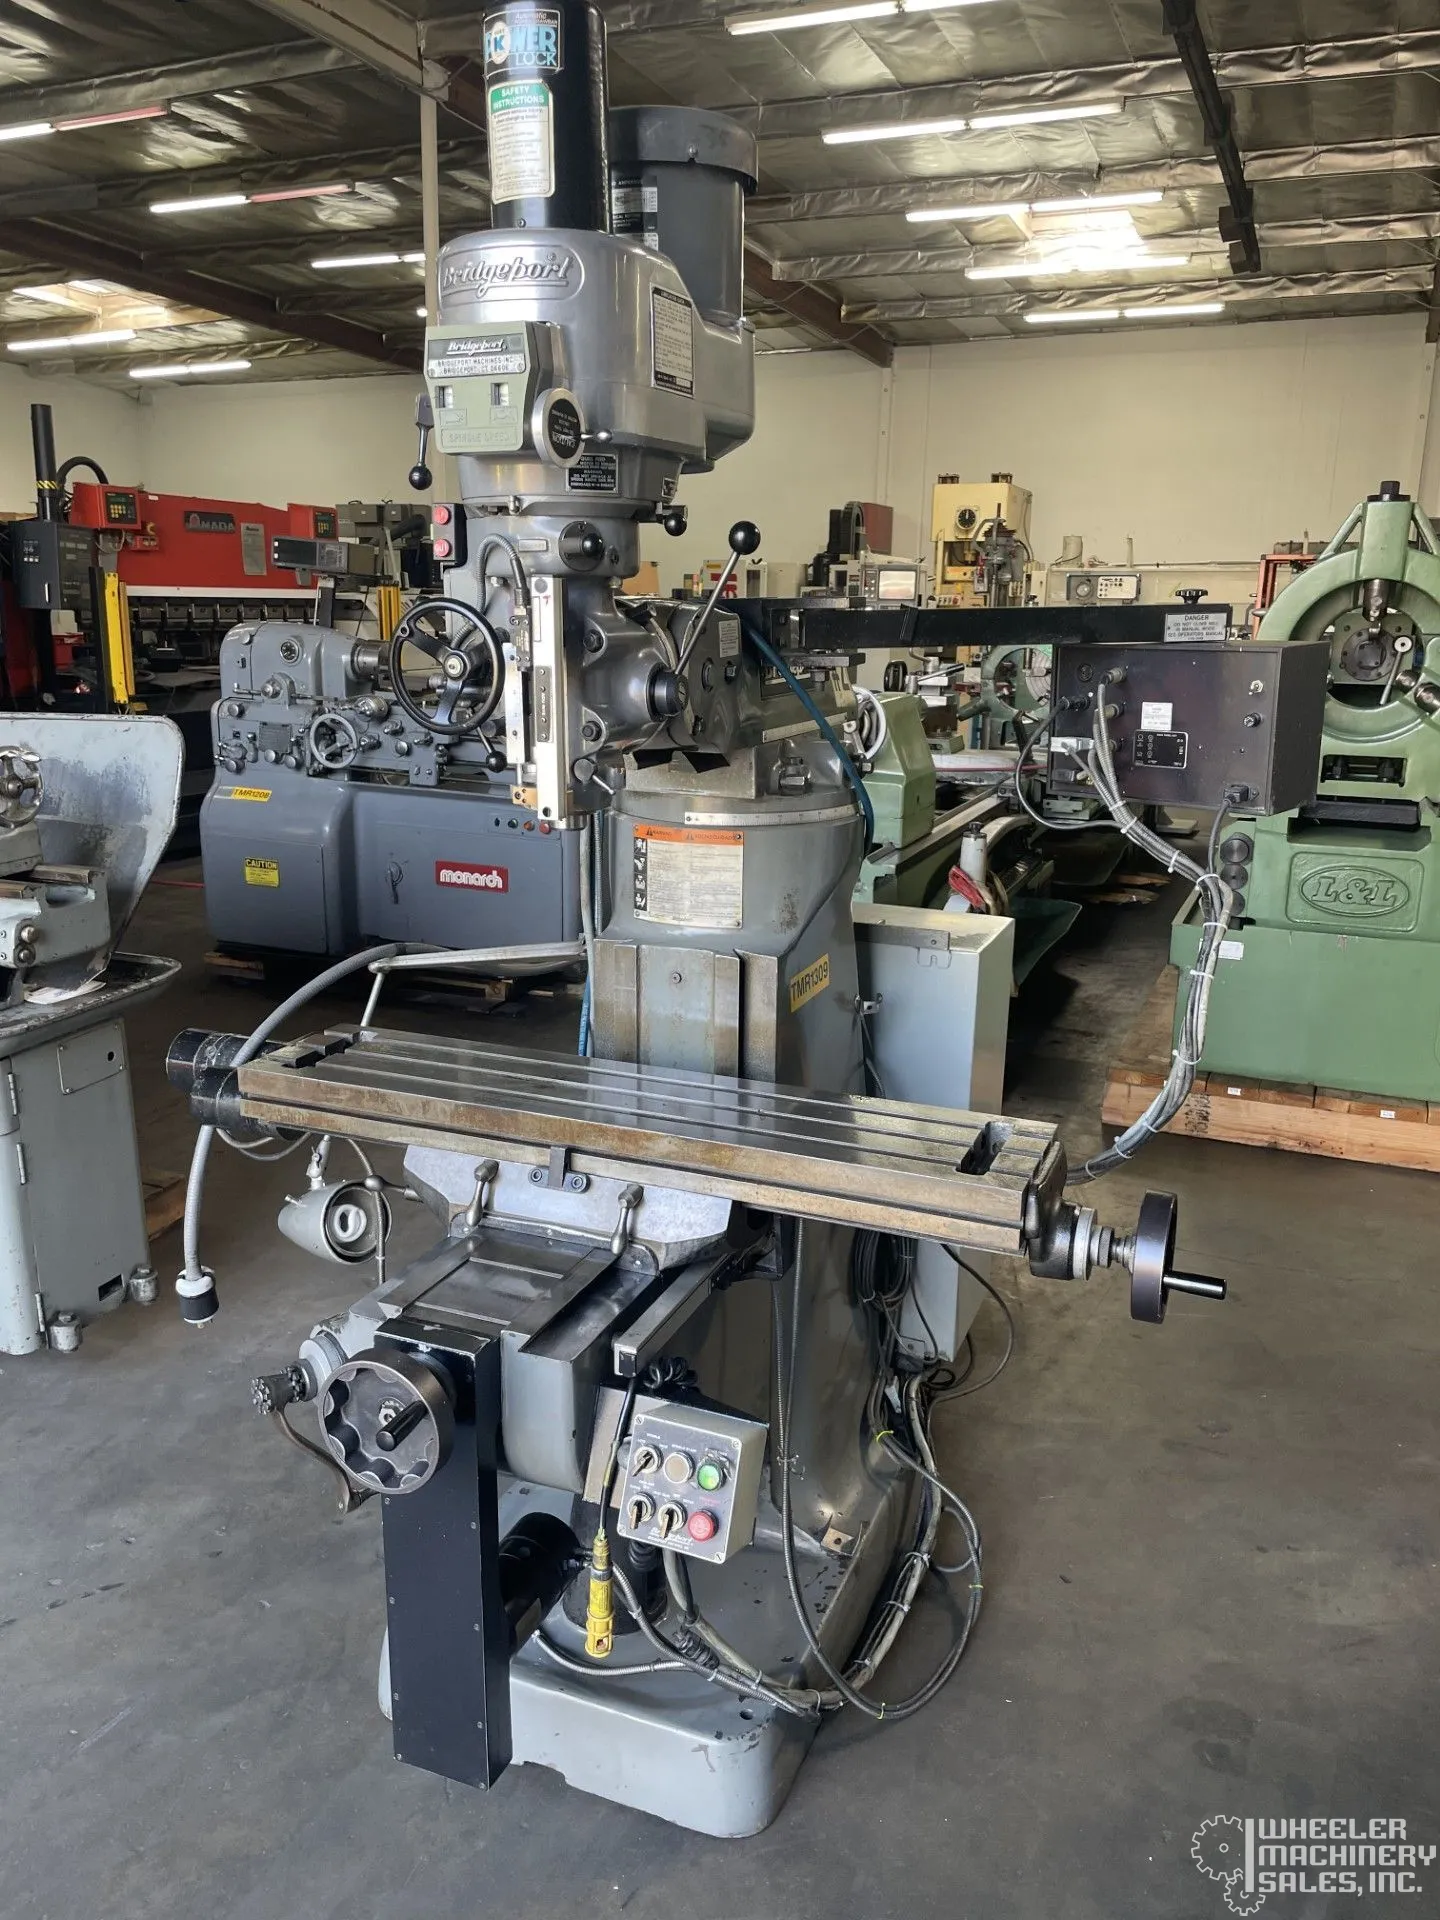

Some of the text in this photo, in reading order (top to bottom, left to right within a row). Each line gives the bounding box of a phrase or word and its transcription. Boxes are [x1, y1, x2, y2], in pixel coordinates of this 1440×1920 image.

[515, 52, 557, 66] LOCK
[501, 86, 530, 97] SAFETY
[443, 256, 574, 298] Bridgeport
[447, 338, 504, 356] Bridgeport
[189, 512, 235, 531] AMADA
[246, 859, 277, 870] CAUTION
[440, 869, 503, 889] monarch
[1311, 875, 1397, 907] L&L
[791, 960, 828, 1001] TMR1309
